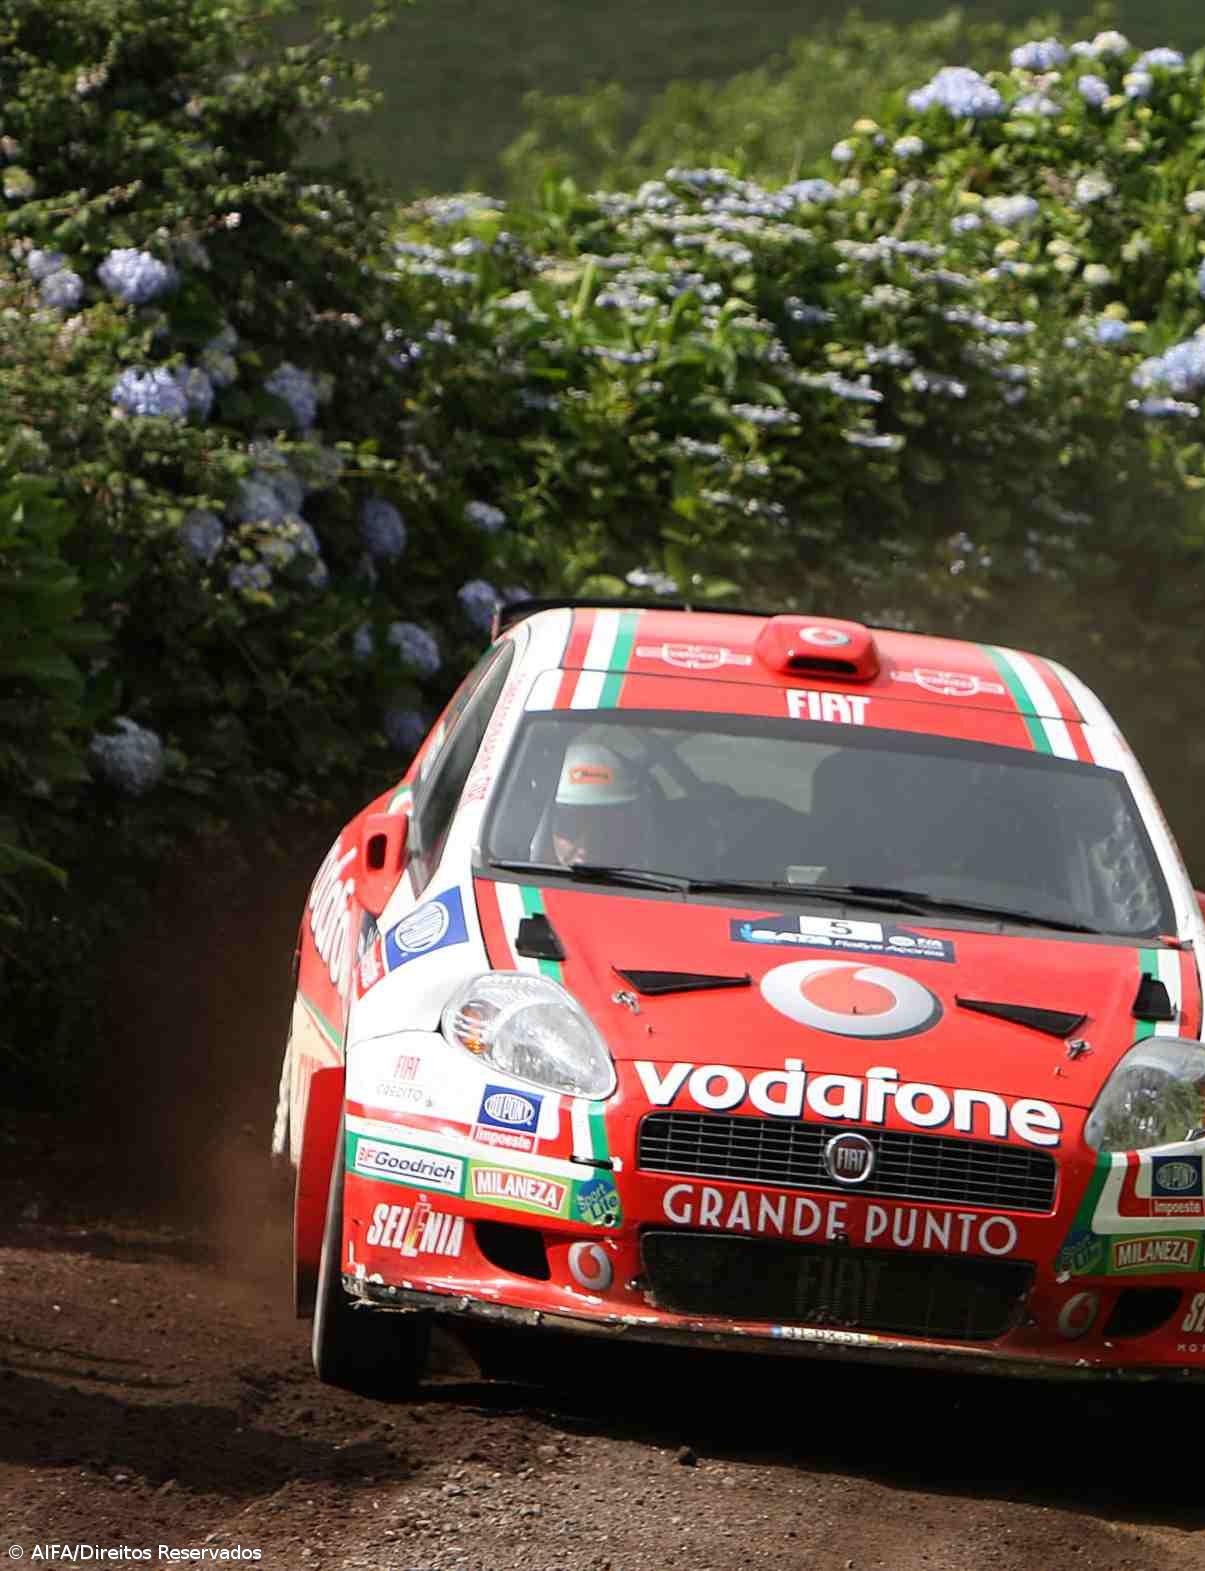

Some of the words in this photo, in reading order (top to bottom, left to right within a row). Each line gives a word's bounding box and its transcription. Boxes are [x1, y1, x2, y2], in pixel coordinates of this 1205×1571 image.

[786, 688, 871, 726] FIAT
[829, 921, 853, 936] 5
[633, 1059, 1063, 1147] vodafone
[836, 1147, 867, 1172] FIAT
[476, 1171, 559, 1209] MILANEZA
[662, 1184, 848, 1240] GRANDE
[865, 1206, 1018, 1255] PUNTO
[1118, 1241, 1190, 1266] MILANEZA
